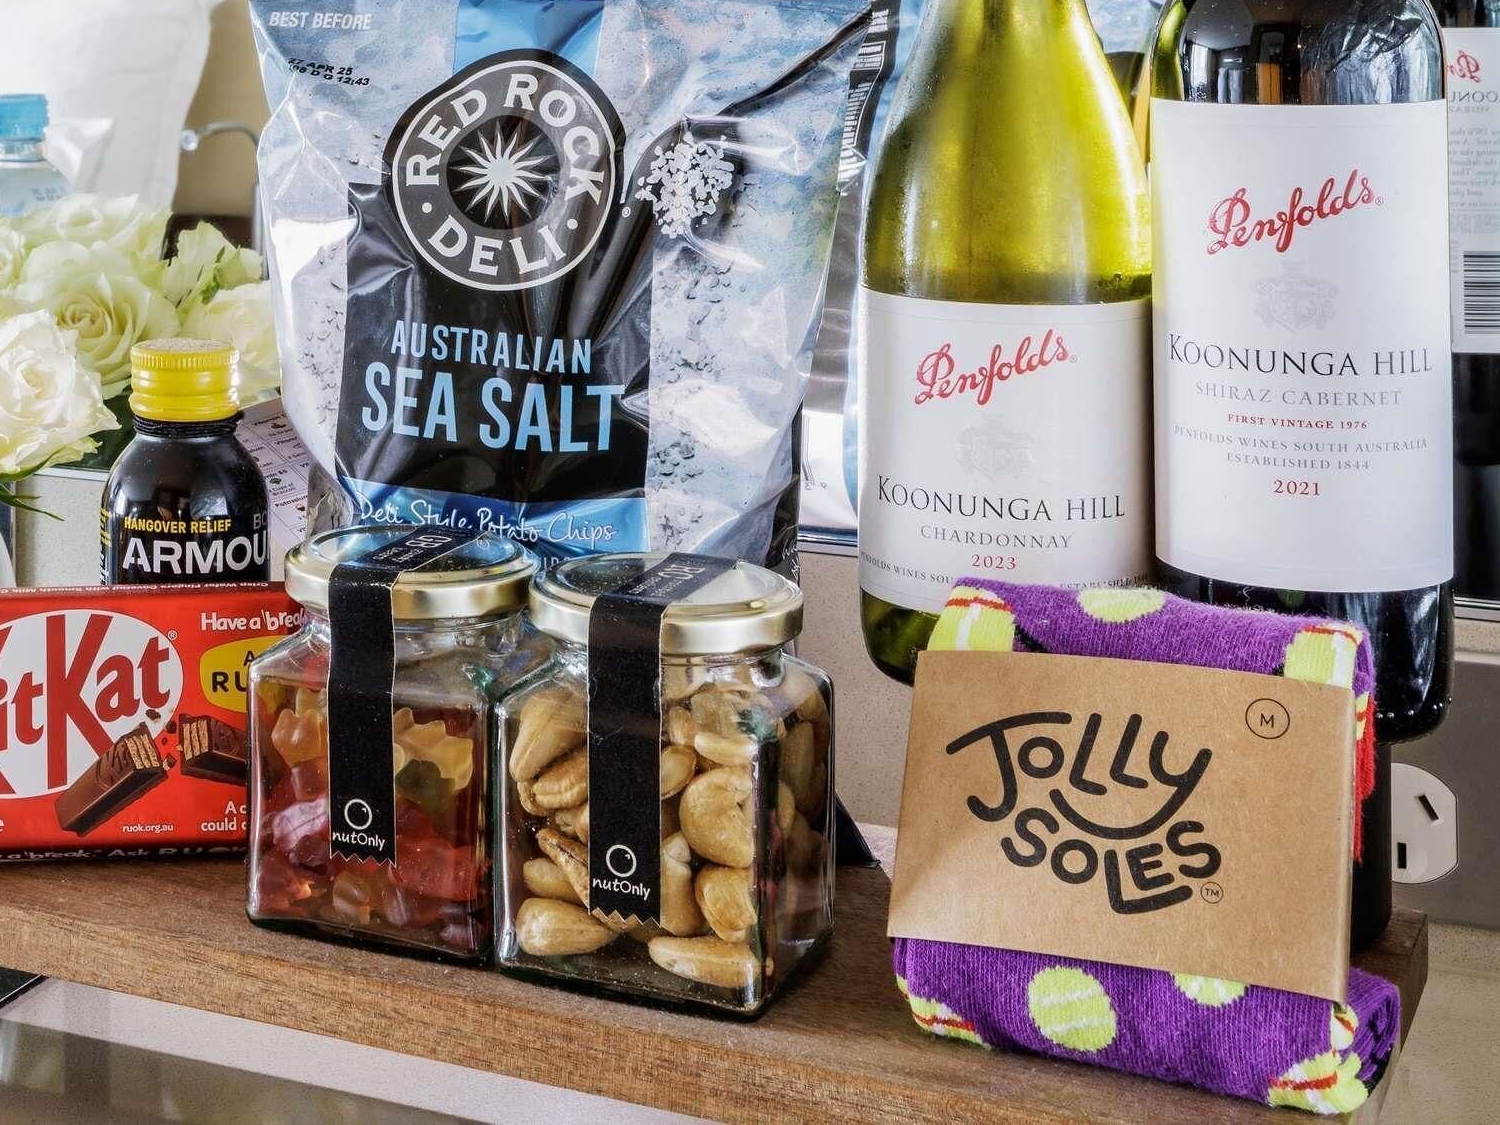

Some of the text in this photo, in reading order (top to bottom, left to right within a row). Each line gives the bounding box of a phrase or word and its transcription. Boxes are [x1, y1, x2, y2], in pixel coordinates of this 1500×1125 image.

[268, 11, 373, 30] BEST BEFORE
[306, 62, 335, 74] APR
[336, 67, 354, 76] 25
[405, 73, 606, 206] RED ROCK
[1206, 169, 1376, 256] Penfolds
[427, 217, 568, 276] DELI
[390, 319, 592, 375] AUSTRALIAN
[1170, 334, 1433, 376] KOONUNGA HILL
[914, 329, 1070, 406] Penfolds
[1196, 381, 1402, 406] SHIRAZ CABERNET
[361, 361, 626, 453] SEA SALT
[1228, 413, 1368, 429] FIRST VINTAGE 1976
[1173, 425, 1428, 453] PENFOLDS WINES SOUTH AUSTRALIA
[1227, 452, 1370, 470] ESTABLISHED 1844
[878, 475, 1125, 521] KOONUNGA HILL
[1273, 479, 1321, 496] 2021
[124, 516, 232, 534] HANGOVER RELIEF
[355, 492, 404, 523] Deli
[476, 508, 543, 543] Potato
[548, 511, 618, 549] Chips
[920, 524, 1073, 548] CHARDONNAY
[122, 535, 268, 574] ARMOU
[971, 554, 1017, 570] 2023
[893, 565, 927, 580] WINES
[930, 573, 954, 584] SOU
[201, 612, 247, 631] Have
[249, 617, 261, 630] a
[122, 823, 174, 834] ruok.org.au
[201, 818, 237, 832] could
[332, 830, 386, 852] nutOnly
[1000, 807, 1223, 915] SOLES
[592, 876, 651, 900] nutOnly
